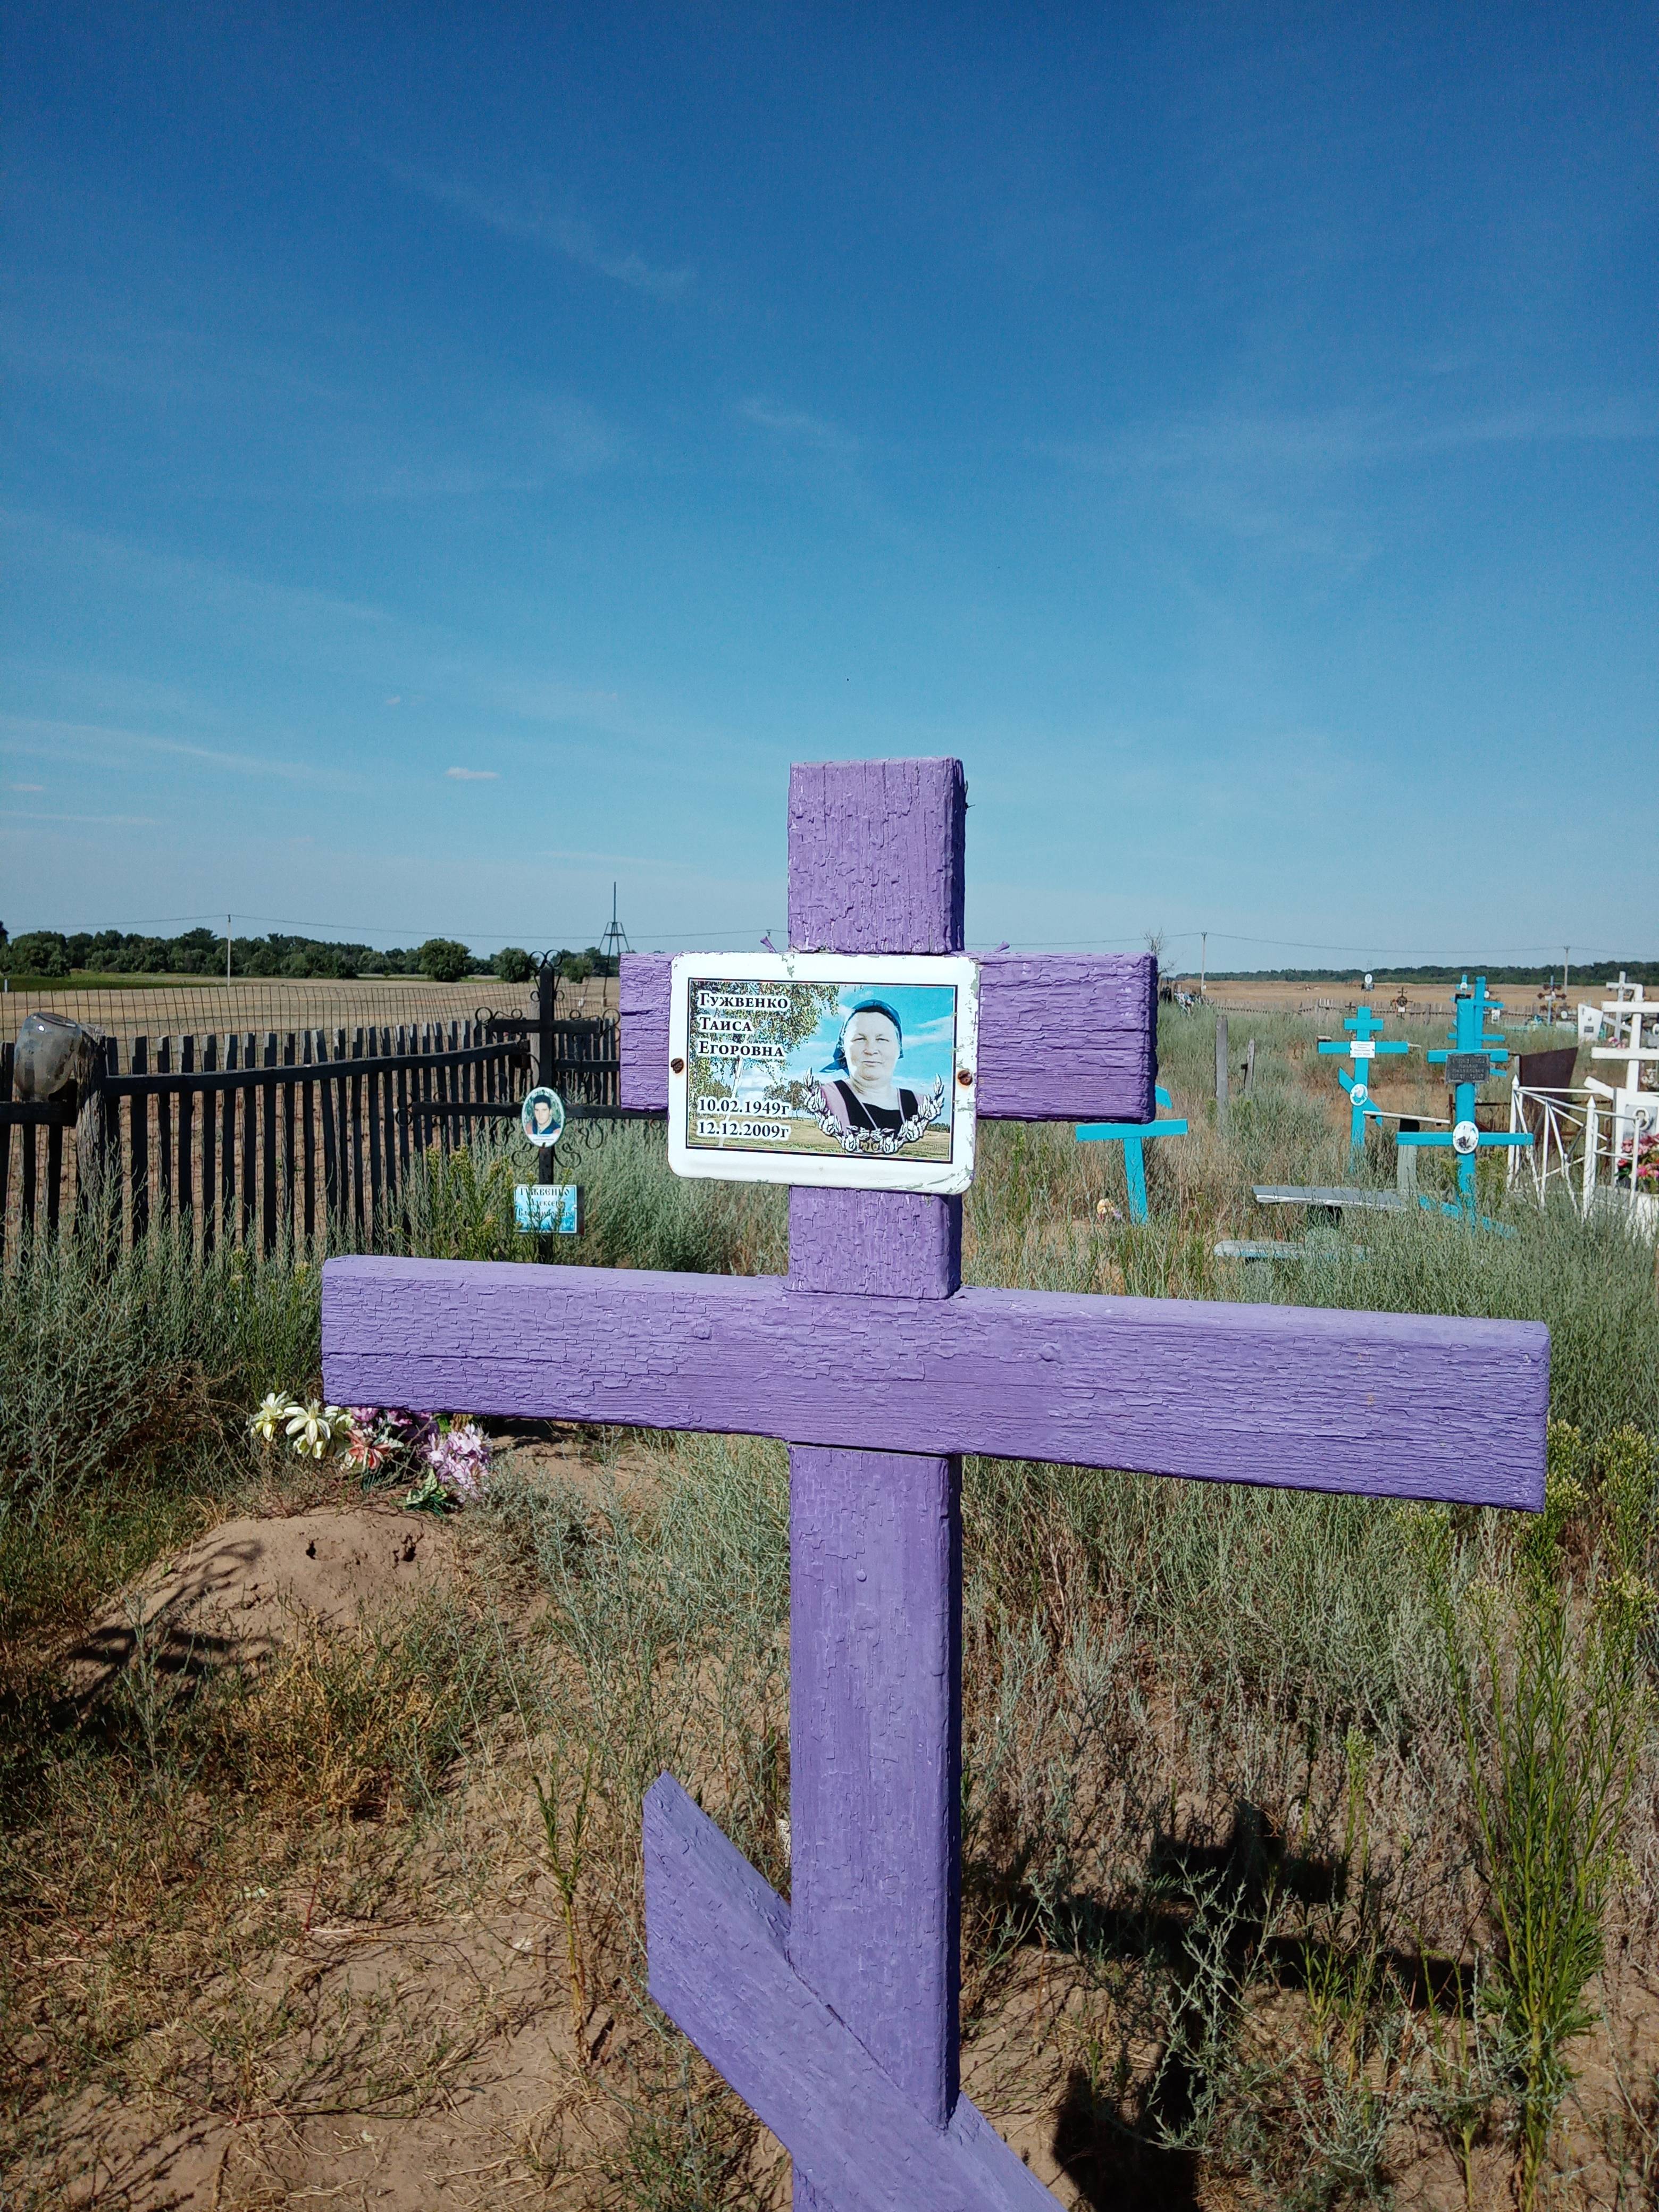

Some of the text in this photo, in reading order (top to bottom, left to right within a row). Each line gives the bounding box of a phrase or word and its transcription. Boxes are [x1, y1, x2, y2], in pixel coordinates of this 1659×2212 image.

[699, 992, 788, 1009] ГУЖВЕНКО
[699, 1016, 752, 1032] ТАИСА
[698, 1040, 784, 1057] ЕГОРОВНА
[699, 1099, 789, 1116] 10.02.1949г
[699, 1121, 789, 1138] 12.12.2009г
